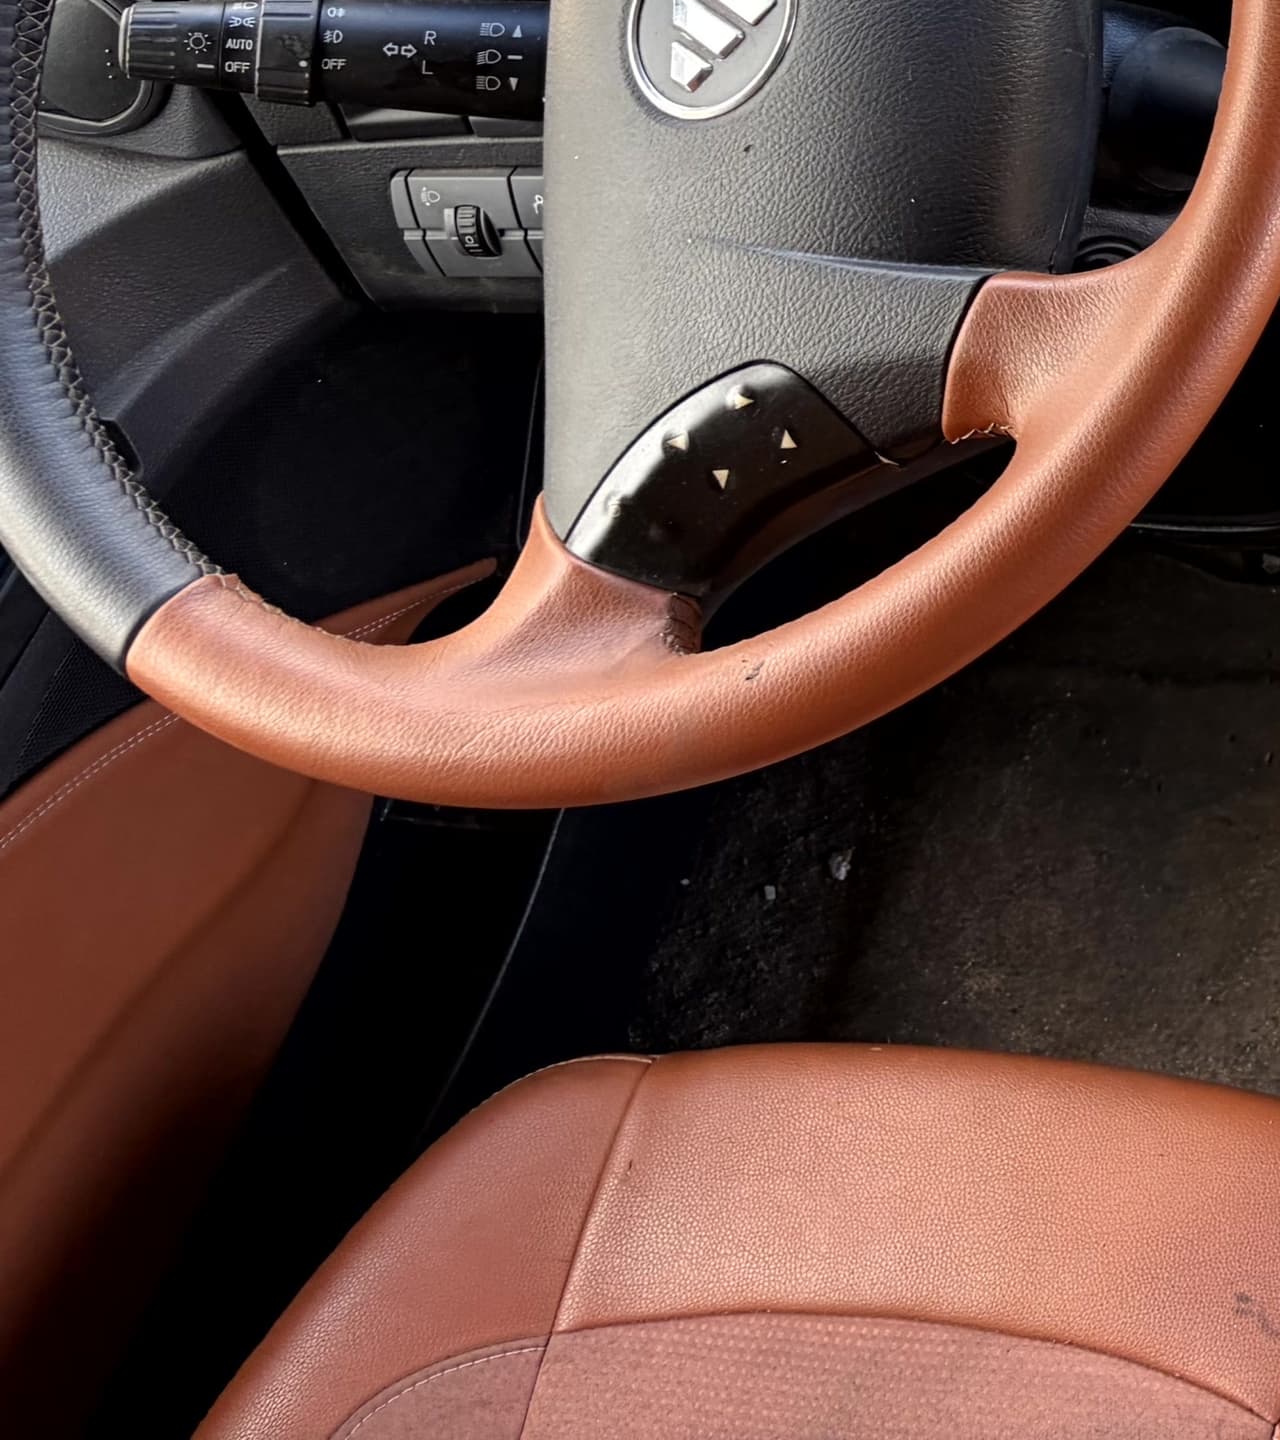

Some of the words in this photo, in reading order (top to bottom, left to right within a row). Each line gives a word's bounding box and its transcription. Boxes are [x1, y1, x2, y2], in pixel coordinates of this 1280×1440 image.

[225, 38, 253, 50] AUTO
[424, 31, 437, 46] R
[224, 61, 251, 73] OFF
[321, 59, 347, 70] OFF
[422, 60, 434, 75] L
